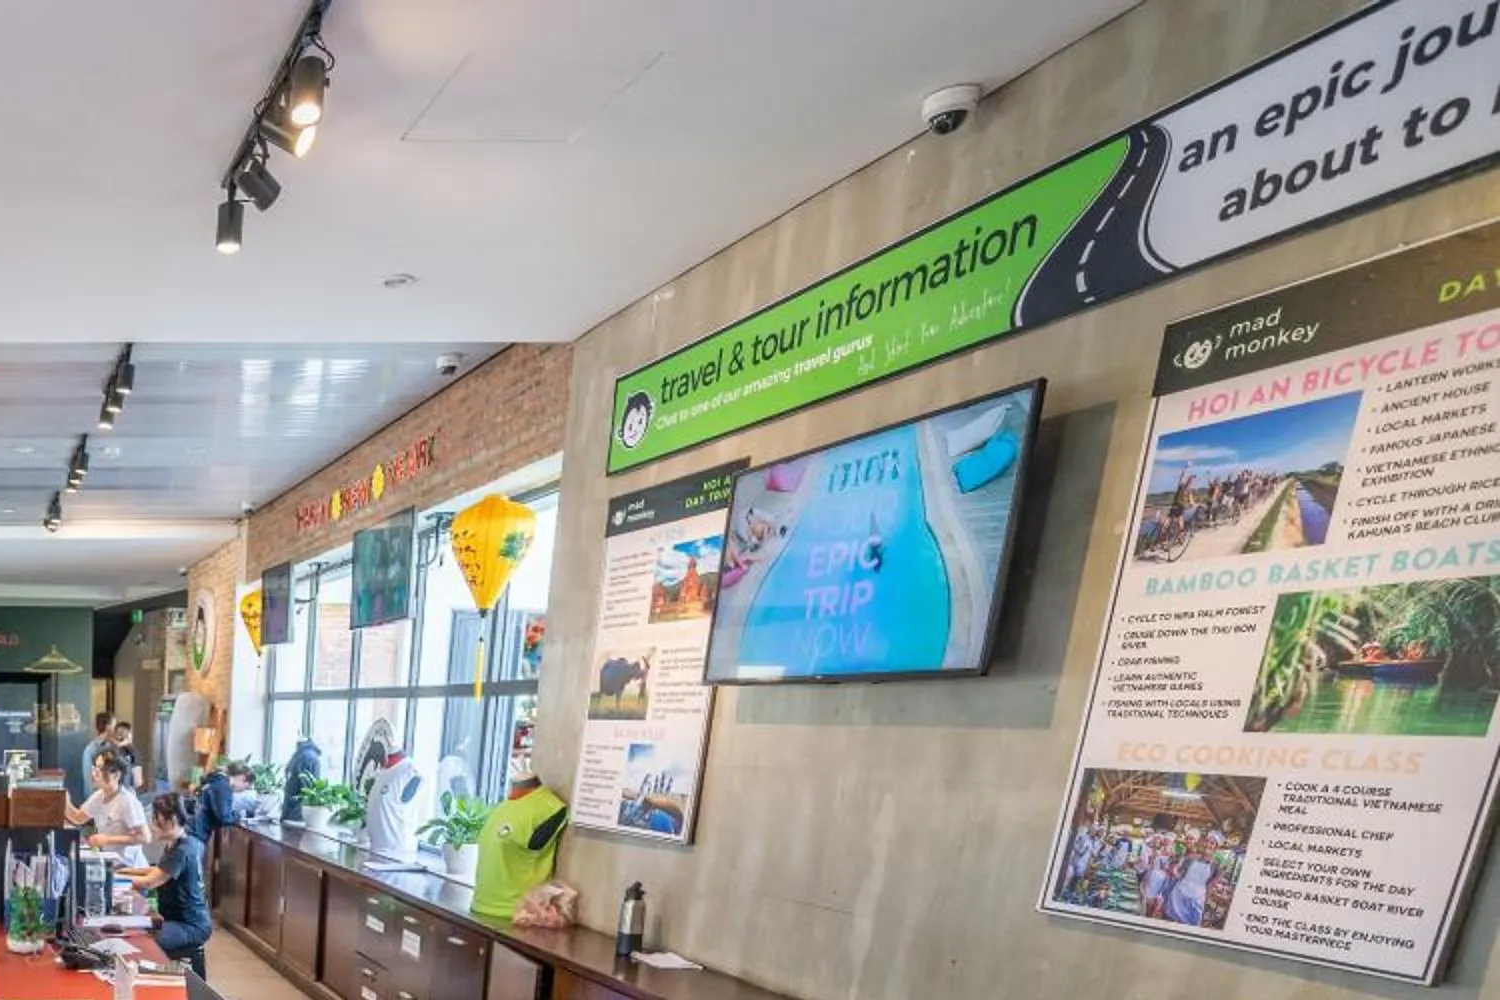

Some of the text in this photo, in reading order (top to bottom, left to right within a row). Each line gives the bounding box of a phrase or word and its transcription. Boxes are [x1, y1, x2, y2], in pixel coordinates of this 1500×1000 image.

[1178, 124, 1237, 172] an
[1254, 60, 1376, 137] epic
[1218, 127, 1383, 222] about
[1402, 97, 1470, 148] to
[660, 213, 1038, 405] travel & tour information
[1229, 306, 1284, 338] mad
[1224, 322, 1320, 361] monkey
[692, 402, 710, 418] one
[721, 390, 742, 409] our
[743, 367, 792, 397] amazing
[794, 346, 832, 375] travel
[832, 333, 874, 362] gurus
[1186, 390, 1240, 424] HOI
[1249, 376, 1291, 407] AN
[1301, 337, 1443, 393] BICYCLE
[1385, 370, 1449, 393] LANTERN
[1380, 381, 1492, 414] ANCIENT HOUSE
[1375, 403, 1488, 434] LOCAL MARKETS
[1369, 421, 1497, 455] FAMOUS JAPANESE
[1365, 451, 1449, 474] VIETNAMESE
[1361, 467, 1435, 488] EXHIBITION
[1355, 493, 1397, 507] CYCLE
[1401, 481, 1467, 500] THROUGH
[1351, 512, 1391, 527] FINISH
[1393, 508, 1419, 521] OFF
[1422, 503, 1459, 518] WITH
[1460, 502, 1472, 513] A
[1347, 522, 1413, 540] KAHUNA'S
[1415, 517, 1461, 532] BEACH
[807, 536, 879, 579] EPIC
[1145, 539, 1500, 597] BAMBOO BASKET BOATS
[804, 580, 874, 620] TRIP
[1127, 612, 1157, 624] CYCLE
[1157, 627, 1188, 639] DOWN
[1190, 626, 1210, 637] THE
[1113, 672, 1144, 683] LEARN
[1107, 709, 1229, 720] TRADITIONAL TECHNIQUES
[1116, 741, 1426, 776] ECO COOKING CLASS
[1285, 781, 1319, 793] COOK
[1320, 783, 1329, 793] A
[1342, 785, 1393, 797] COURSE
[1278, 805, 1309, 816] MEAL
[1282, 793, 1443, 814] TRADITIONAL VIETNAMESE
[1273, 821, 1395, 842] PROFESSIONAL CHEF
[1267, 839, 1363, 858] LOCAL MARKETS
[1262, 857, 1373, 879] SELECT YOUR OWN
[1259, 868, 1416, 897] INGREDIENTS FOR THE DAY
[1303, 892, 1350, 908] BASKET
[1351, 899, 1385, 913] BOAT
[1244, 924, 1353, 951] YOUR MASTERPIECE
[1245, 913, 1416, 950] END THE CLASS BY ENJOYING
